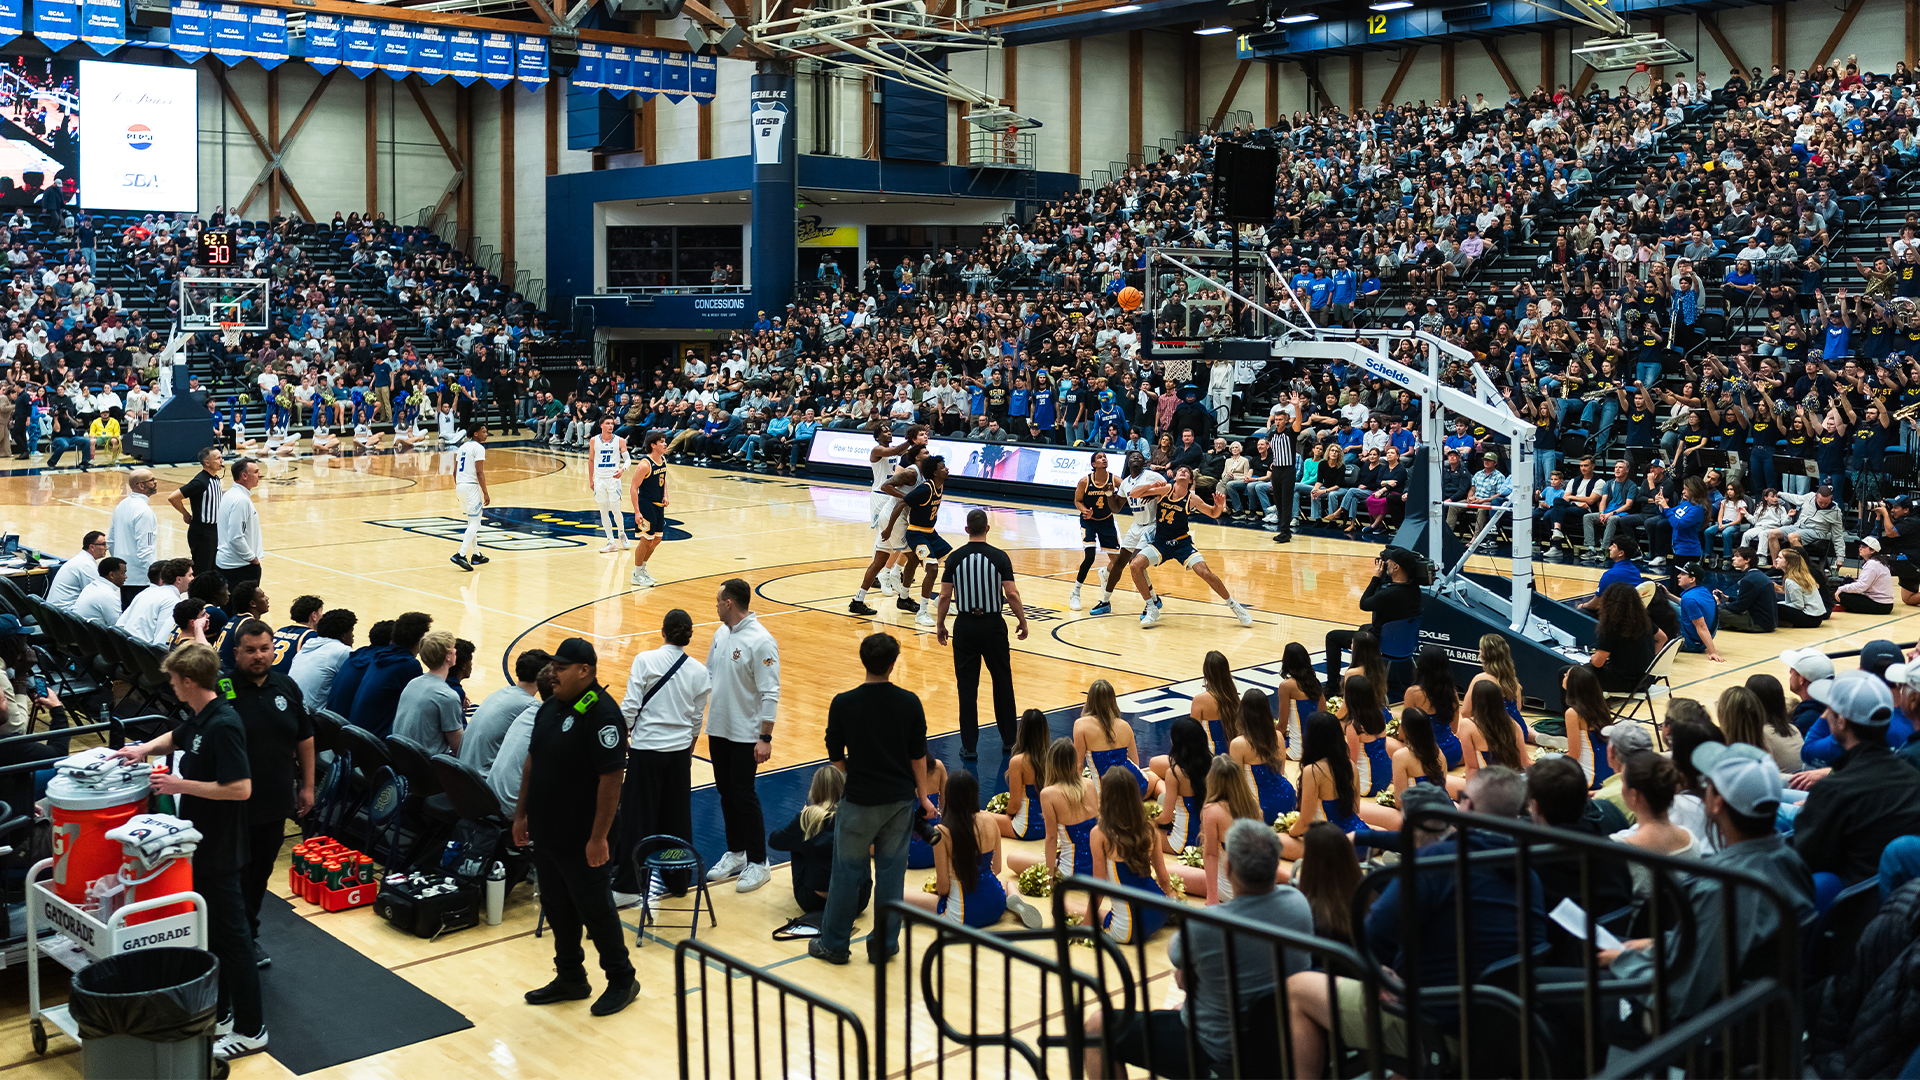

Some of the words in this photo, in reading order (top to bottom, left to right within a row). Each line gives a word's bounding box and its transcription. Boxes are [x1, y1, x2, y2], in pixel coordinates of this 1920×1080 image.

[39, 15, 72, 24] Tournament
[88, 19, 120, 28] Champions
[1366, 14, 1386, 34] 12
[216, 32, 244, 40] Tournament
[756, 117, 780, 125] UCSB
[761, 127, 771, 137] 6
[122, 173, 158, 188] SBA
[204, 234, 227, 246] 52.7
[799, 229, 820, 242] Snack
[822, 228, 836, 236] Bar
[209, 245, 229, 263] 30
[694, 299, 745, 309] CONCESSIONS
[1365, 357, 1409, 385] Schelde
[833, 444, 847, 452] How
[459, 457, 465, 472] 3
[1054, 457, 1076, 469] SBA
[1095, 496, 1104, 508] 4
[1130, 497, 1138, 505] 34
[1159, 509, 1176, 524] 14
[1419, 630, 1450, 641] EXUS
[359, 870, 367, 880] G
[348, 889, 360, 904] G
[45, 902, 96, 946] GATORADE
[123, 926, 192, 951] GATORADE
